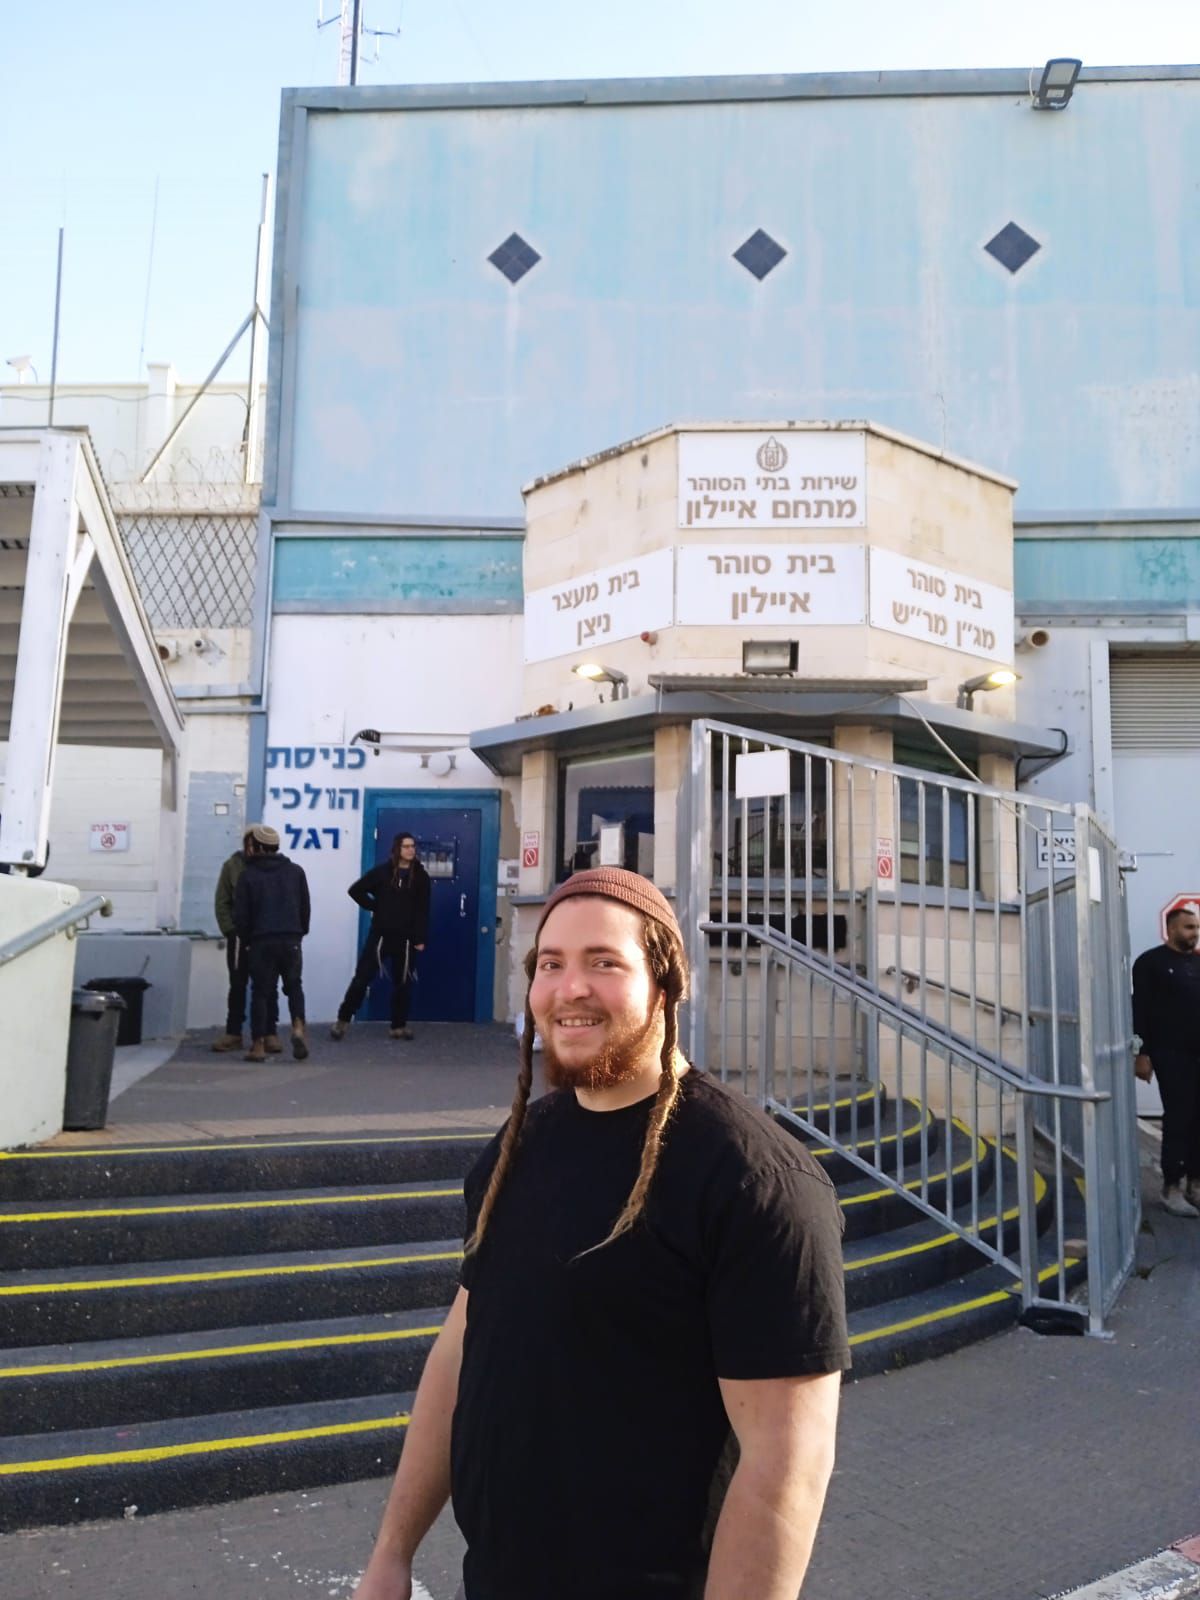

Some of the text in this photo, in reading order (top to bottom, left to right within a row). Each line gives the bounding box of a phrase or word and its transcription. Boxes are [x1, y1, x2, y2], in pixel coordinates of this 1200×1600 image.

[687, 475, 857, 492] שירות בתי הסוהר
[686, 494, 857, 526] מתחם איילון
[707, 554, 836, 575] בית סוהר
[551, 569, 640, 612] בית מעצר
[731, 585, 811, 620] איילון
[906, 567, 983, 609] בית סוהר
[576, 612, 612, 646] ניצן
[266, 746, 367, 770] כניסת
[269, 782, 361, 811] הולכי
[284, 823, 341, 850] רגל
